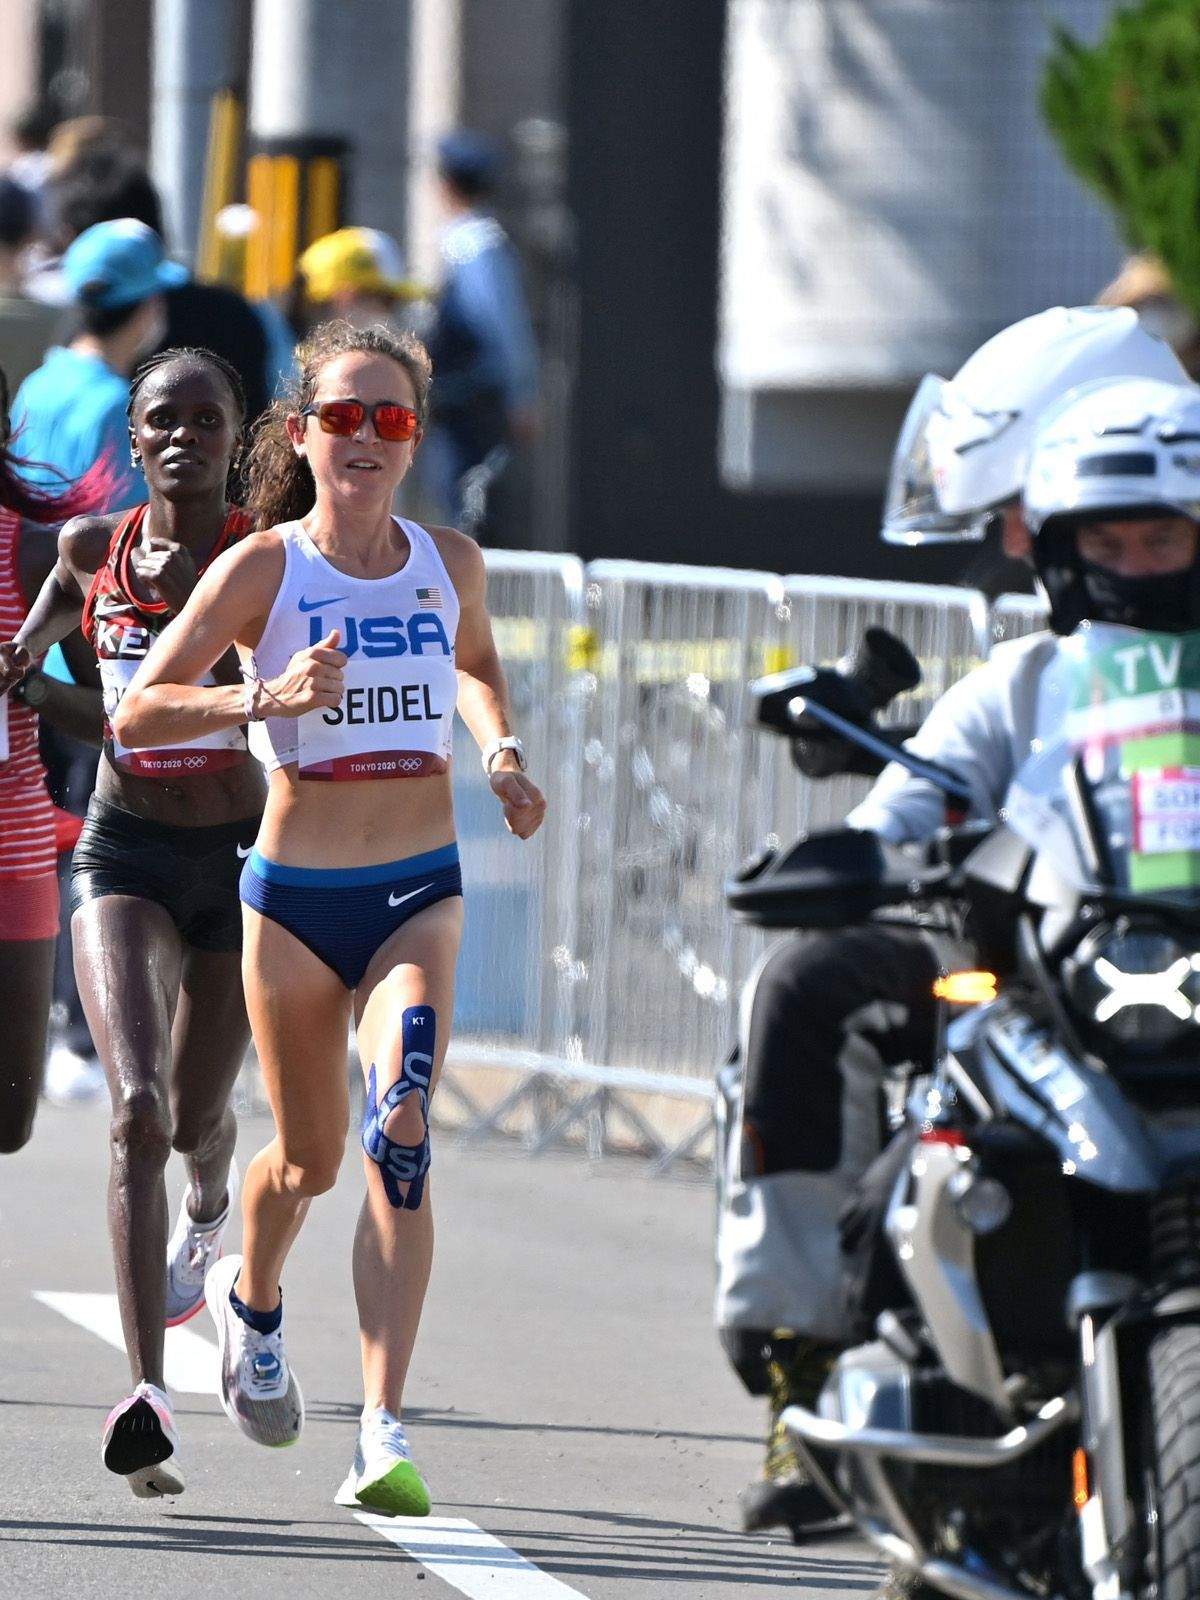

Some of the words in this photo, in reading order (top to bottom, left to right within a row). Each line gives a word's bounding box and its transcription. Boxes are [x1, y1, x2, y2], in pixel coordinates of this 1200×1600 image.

[97, 620, 158, 656] KE
[309, 613, 451, 658] USA
[1113, 639, 1182, 693] TV
[140, 760, 162, 769] TOKYO
[162, 760, 182, 769] 2020
[350, 763, 376, 772] TOKYO
[377, 761, 396, 771] 2020
[412, 1016, 426, 1026] KT
